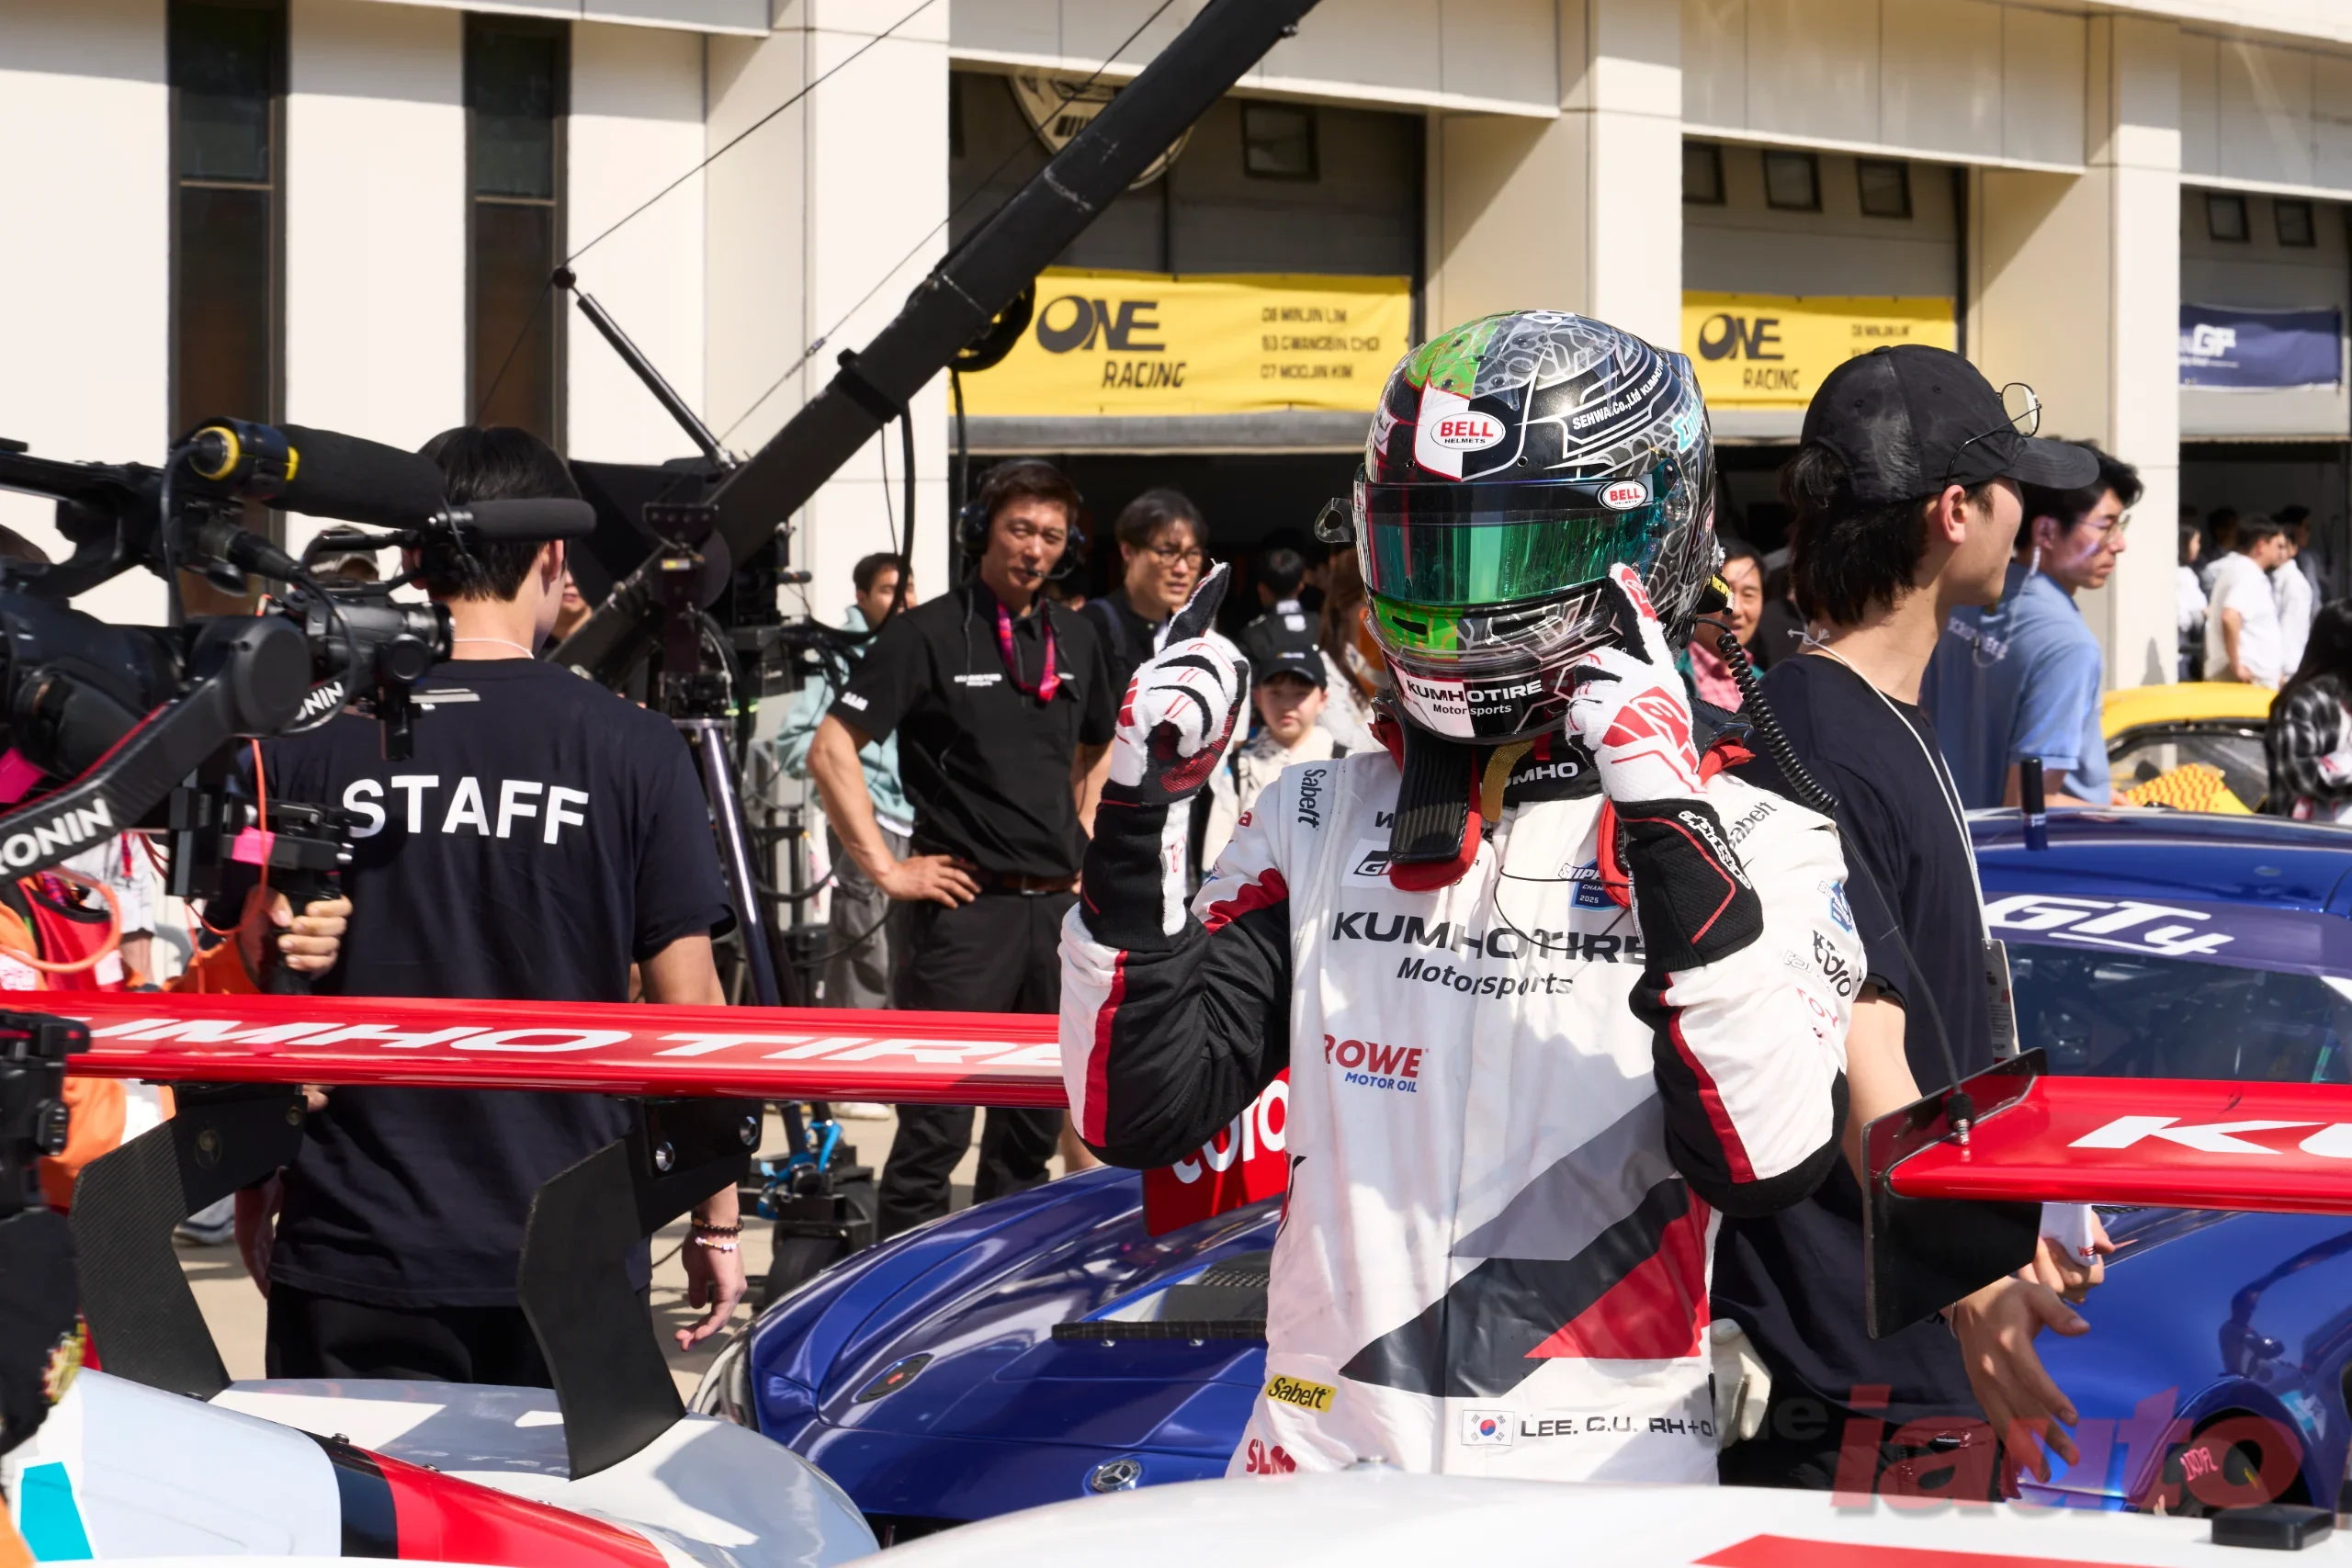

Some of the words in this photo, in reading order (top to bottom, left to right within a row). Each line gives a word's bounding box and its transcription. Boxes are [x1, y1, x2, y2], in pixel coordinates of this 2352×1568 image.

[1036, 295, 1165, 354] ONE
[1698, 313, 1785, 360] ONE
[1102, 360, 1186, 389] RACING
[1743, 368, 1799, 390] RACING
[1440, 421, 1494, 437] BELL
[1610, 488, 1641, 502] BELL
[1407, 679, 1543, 703] KUMHOTIRE
[1433, 703, 1512, 716] Motorsports
[343, 774, 589, 844] STAFF
[1298, 769, 1327, 829] Sabelt
[1579, 895, 1600, 904] 2025
[1983, 894, 2234, 955] GT4
[1396, 957, 1574, 999] Motorsports
[1345, 1071, 1396, 1089] MOTOR
[1396, 1077, 1418, 1093] OIL
[1268, 1377, 1327, 1409] Sabelt
[1521, 1420, 1578, 1437] LEE.
